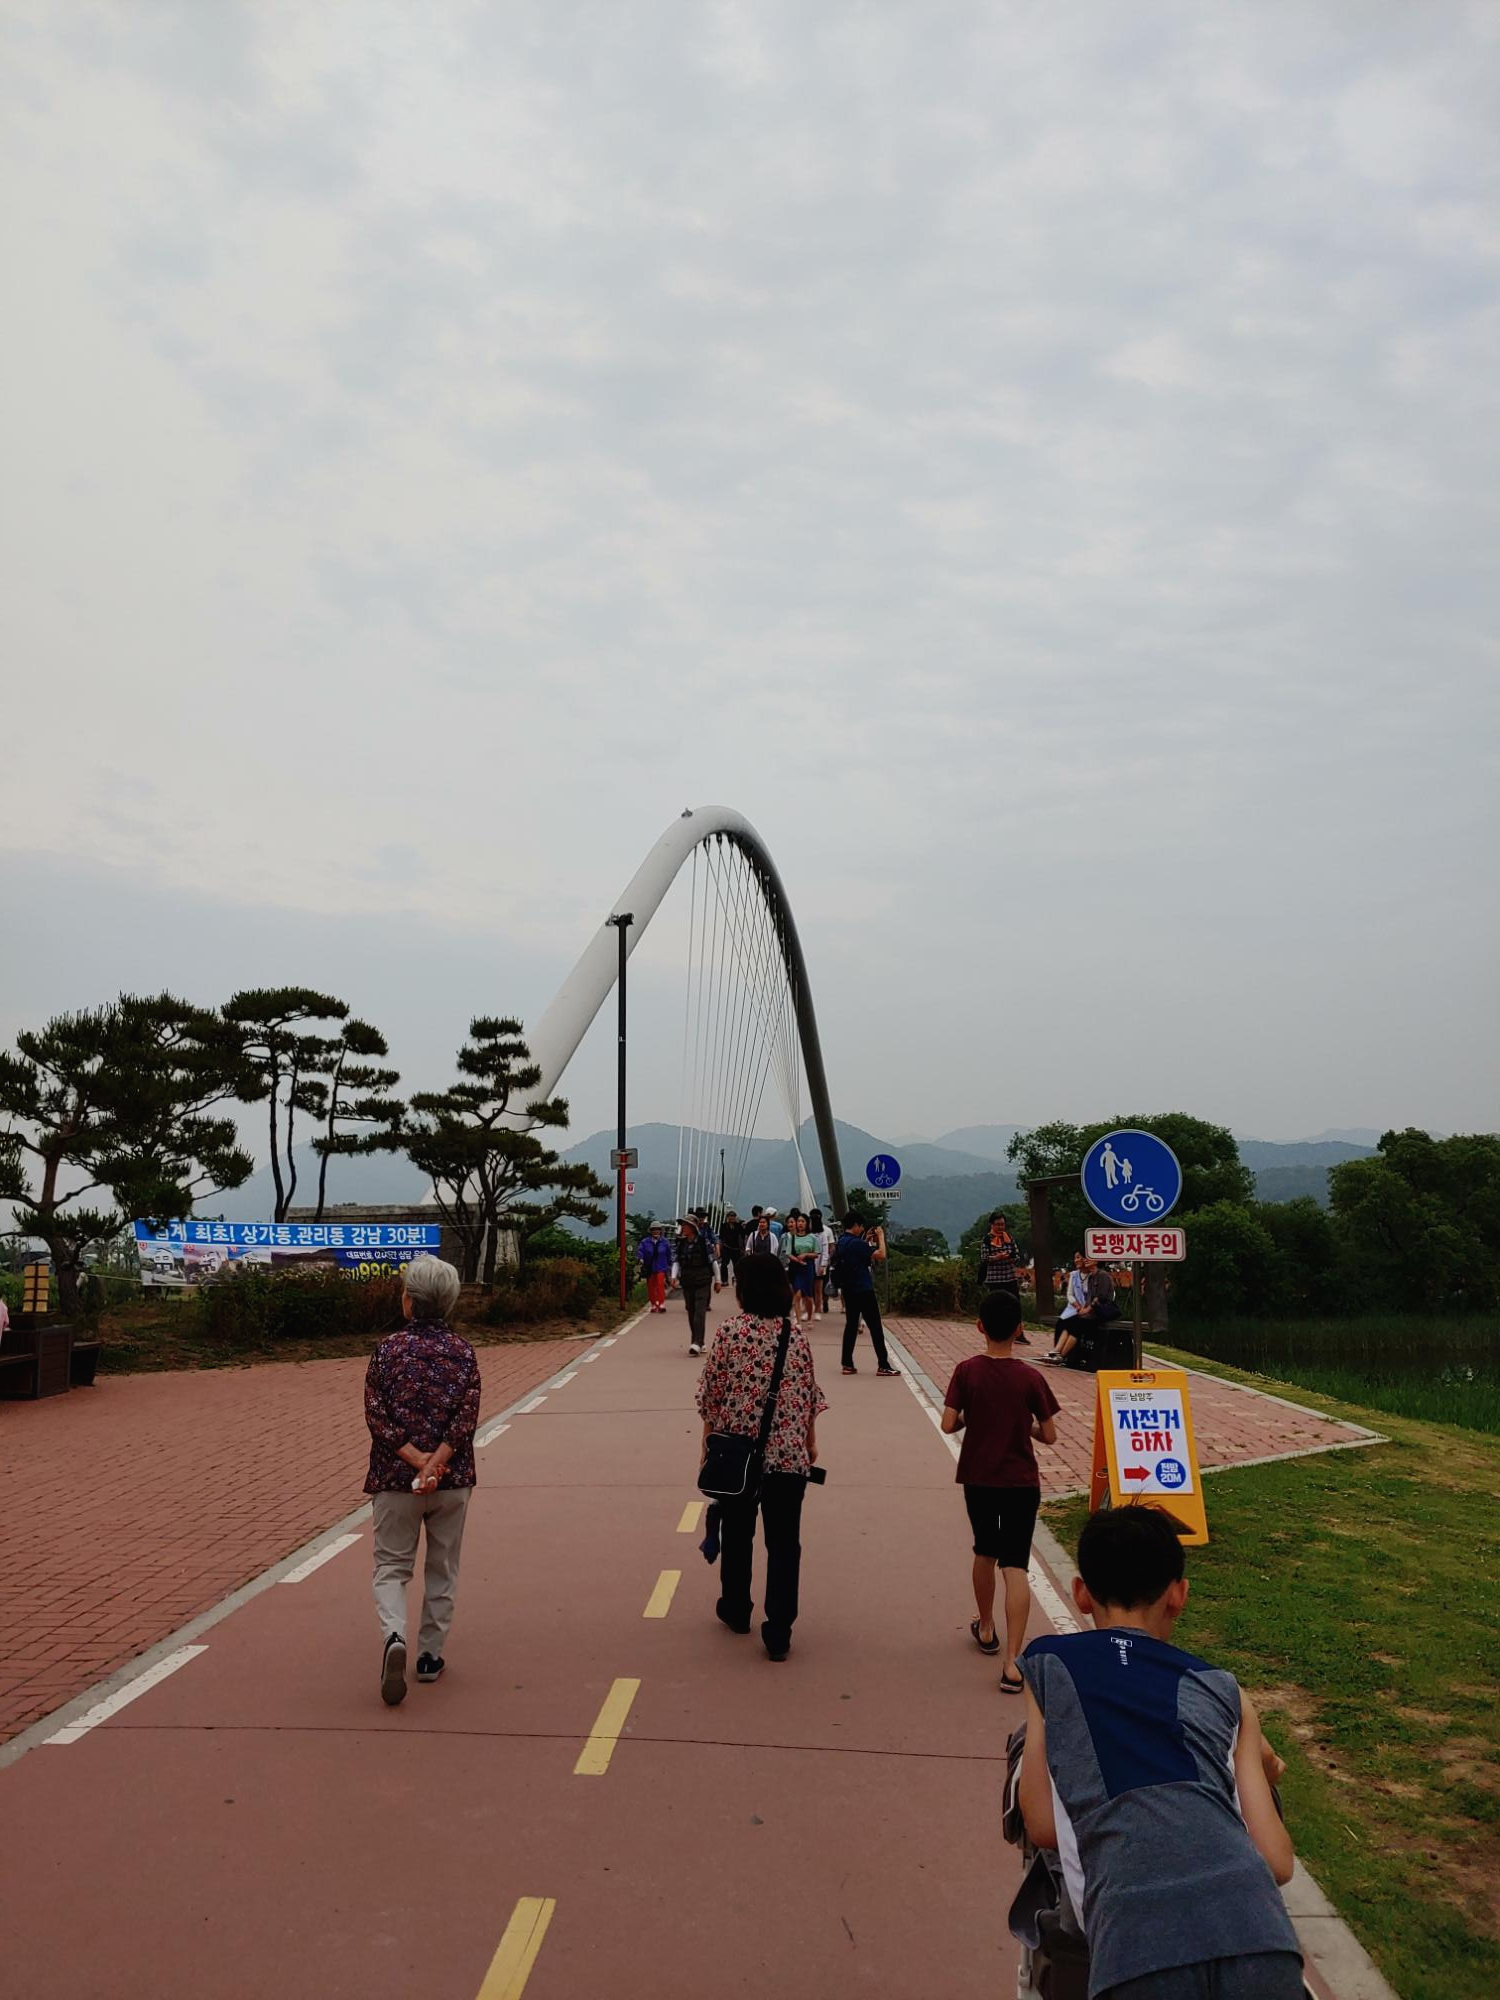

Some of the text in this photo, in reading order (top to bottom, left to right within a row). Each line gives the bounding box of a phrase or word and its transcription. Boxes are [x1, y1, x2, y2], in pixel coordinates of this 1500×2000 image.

[195, 1224, 236, 1243] 최초!
[351, 1226, 382, 1245] 강남
[387, 1227, 426, 1245] 30분!
[1092, 1233, 1178, 1255] 보행자주의
[1129, 1392, 1154, 1402] 남양주
[1117, 1409, 1180, 1429] 자전거
[1130, 1431, 1173, 1452] 하차
[1160, 1473, 1182, 1483] 20M
